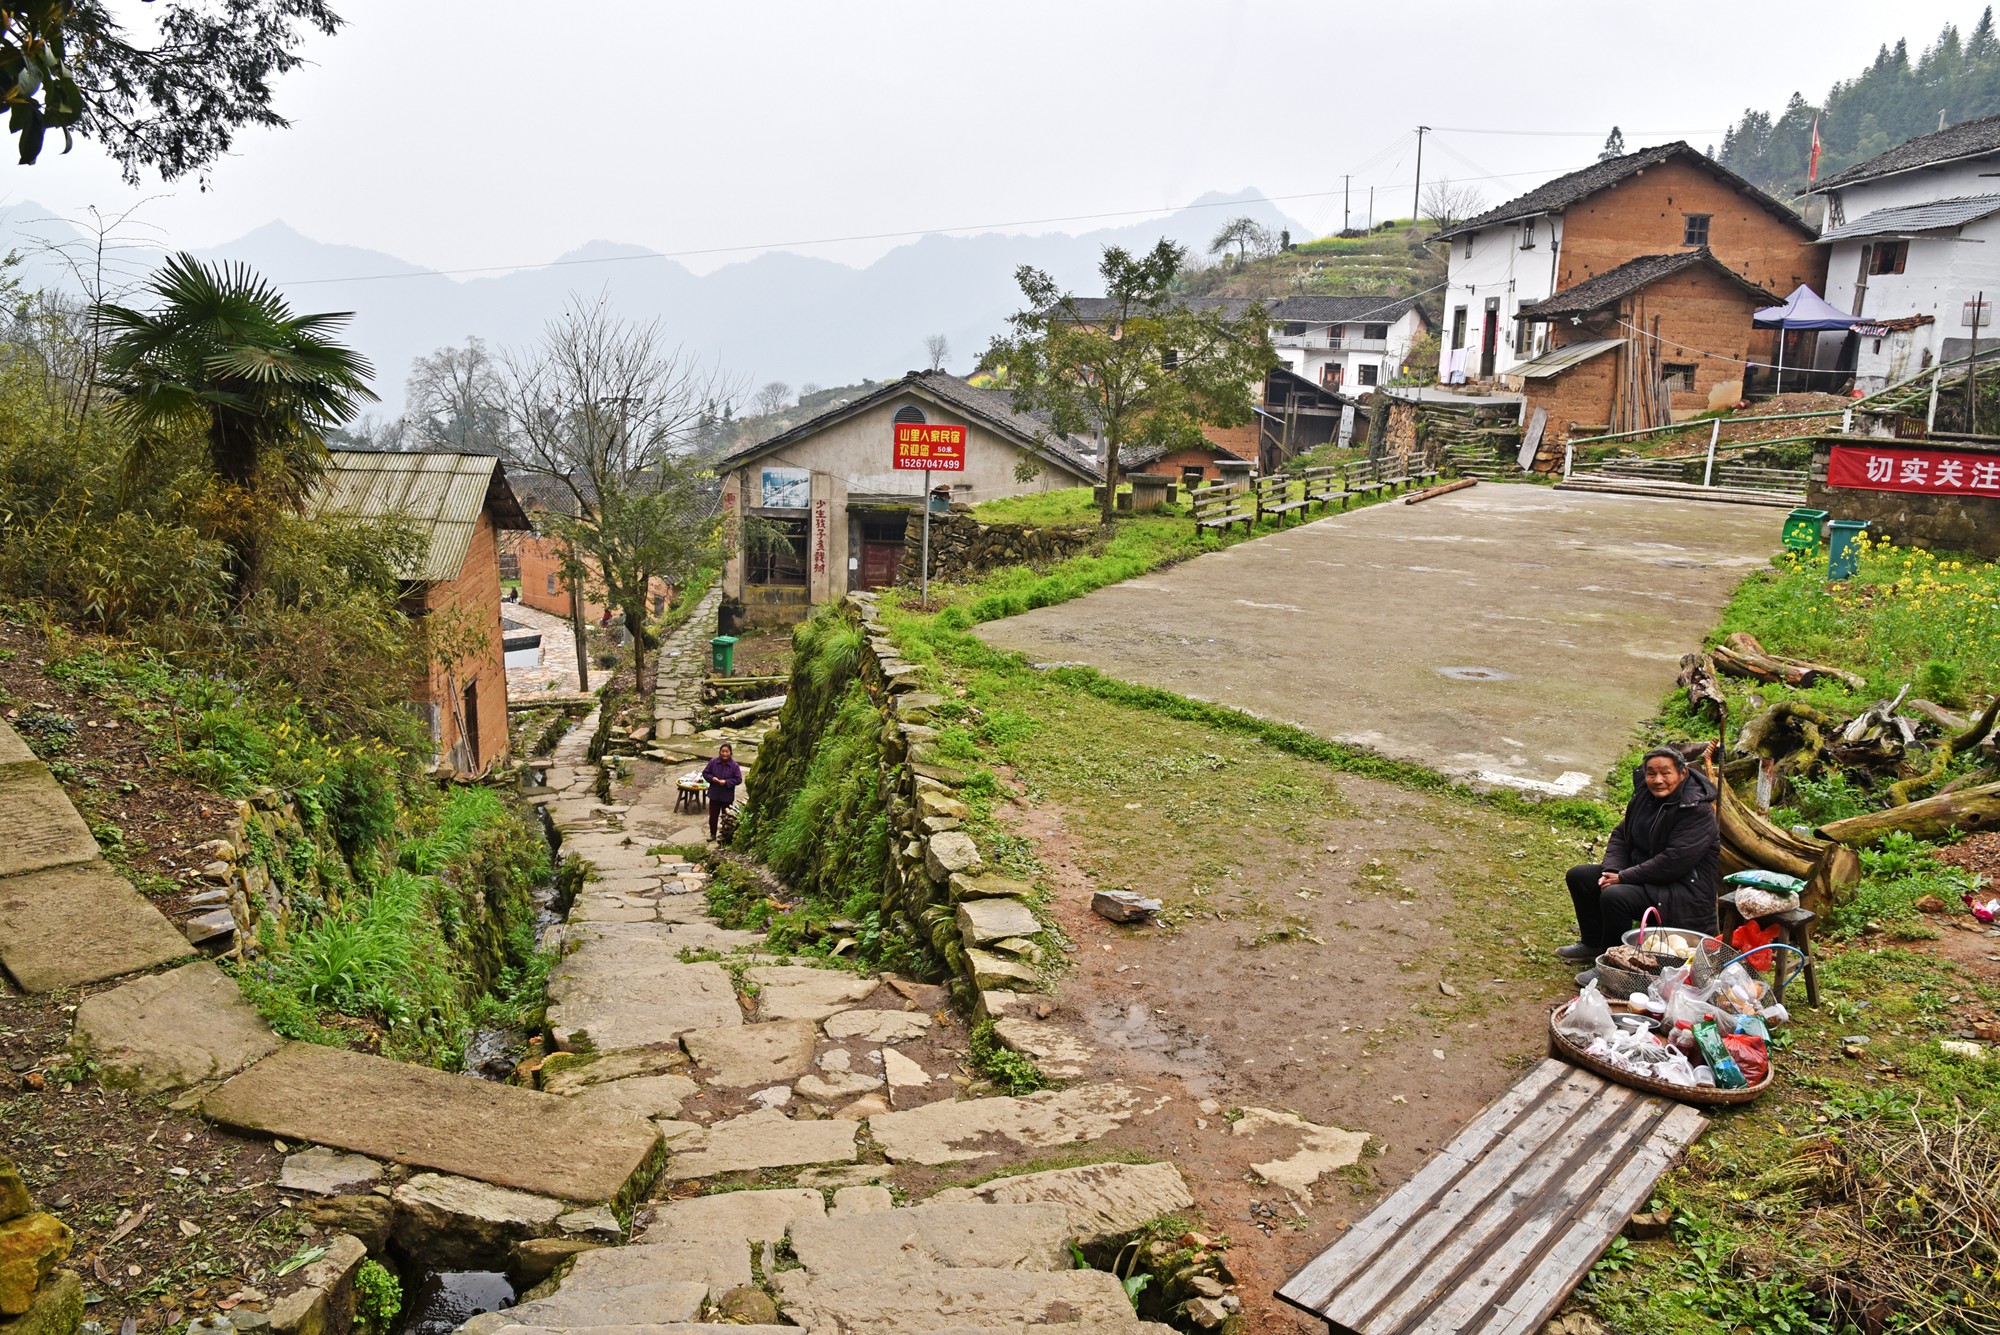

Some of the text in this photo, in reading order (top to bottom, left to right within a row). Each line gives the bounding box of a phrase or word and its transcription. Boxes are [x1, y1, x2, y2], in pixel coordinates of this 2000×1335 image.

[900, 429, 960, 443] 山里人家民宿
[900, 444, 930, 457] 欢迎您
[900, 459, 960, 469] 15267047499
[1865, 456, 2000, 489] 切实关注
